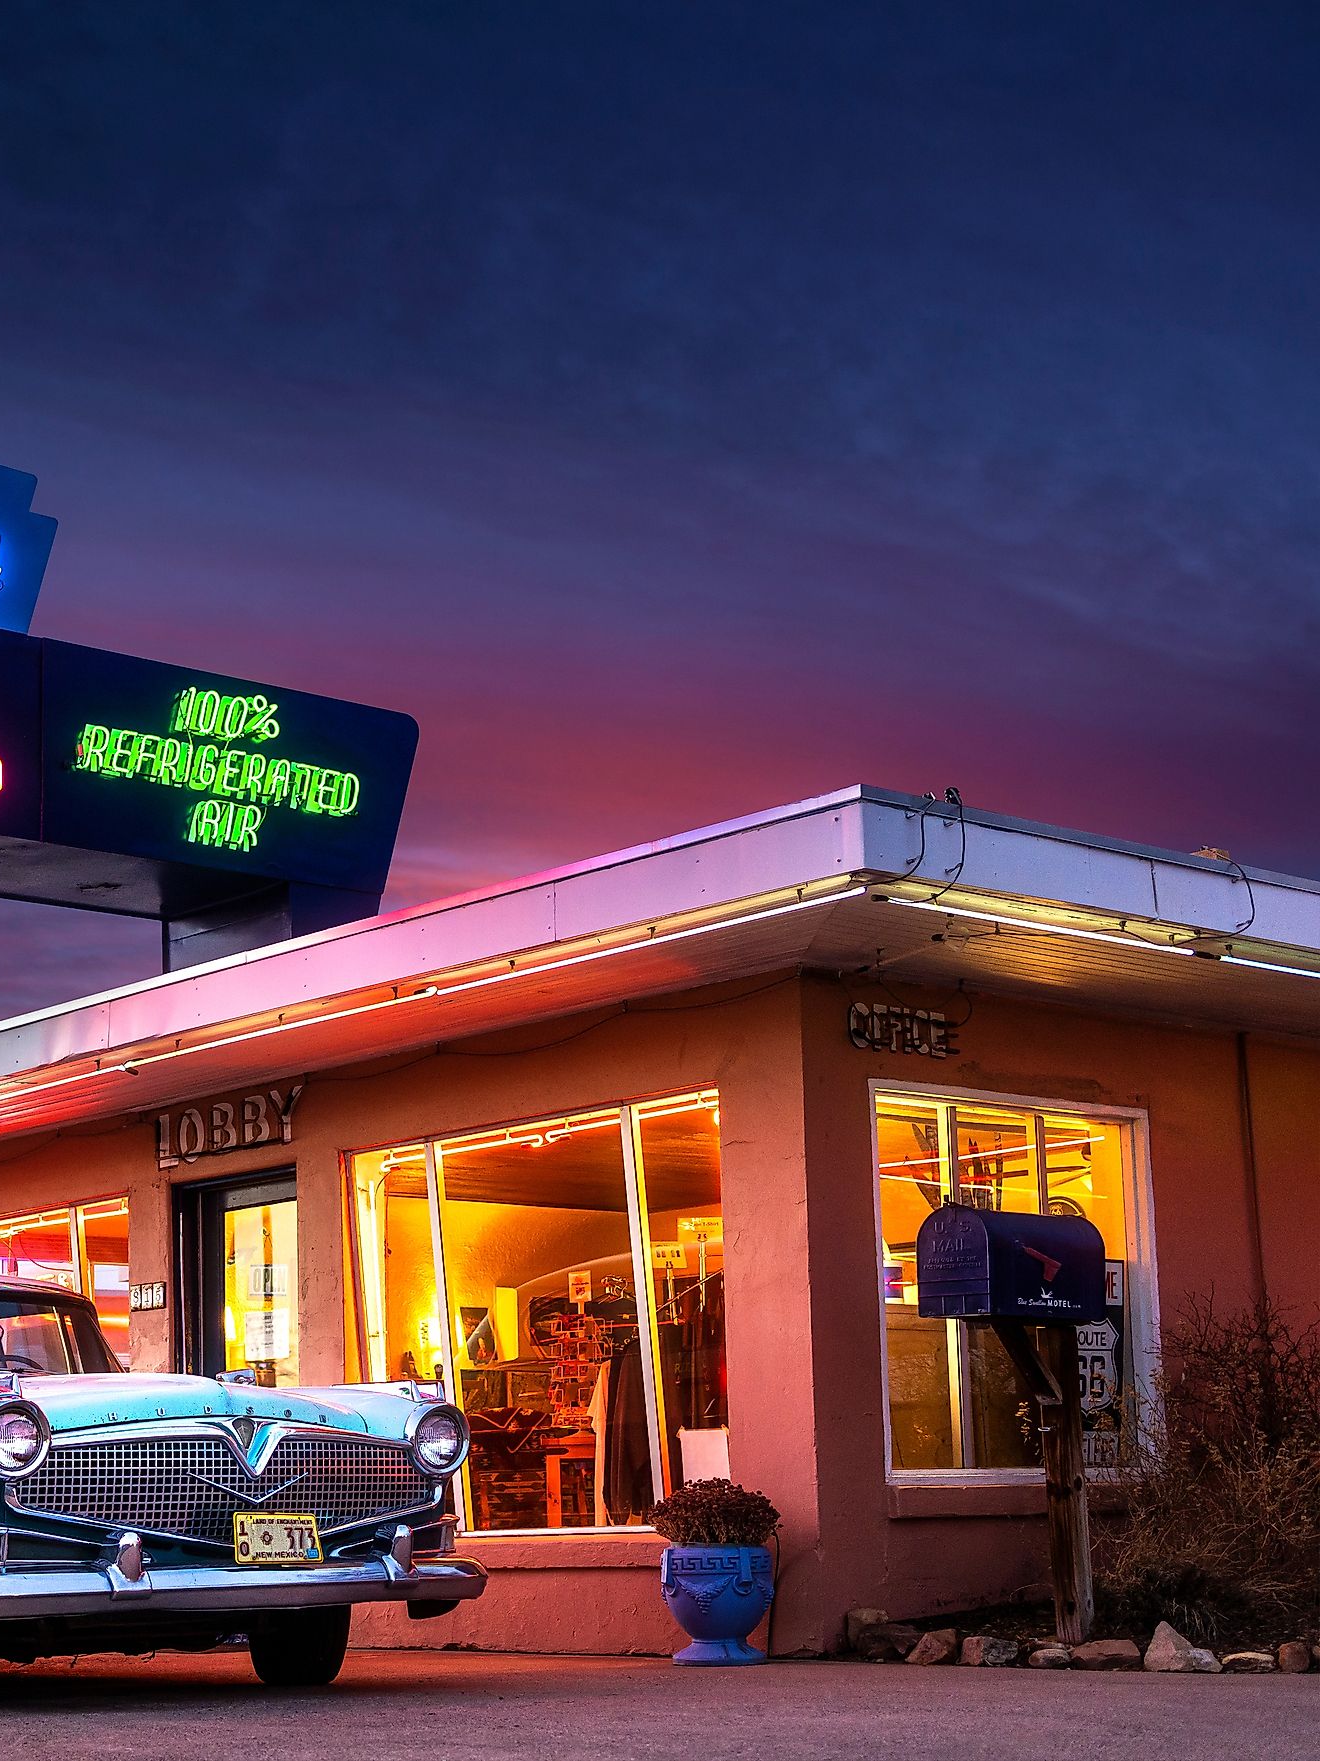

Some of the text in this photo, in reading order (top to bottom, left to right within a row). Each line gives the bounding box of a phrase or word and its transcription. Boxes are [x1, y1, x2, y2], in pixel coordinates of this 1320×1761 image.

[175, 687, 280, 741] 100%
[77, 724, 360, 816] REFRIGERATED
[188, 800, 263, 852] AIR
[848, 1002, 956, 1059] OFFICE
[157, 1086, 302, 1169] LOBBY
[932, 1238, 970, 1253] MAIL
[133, 1288, 162, 1304] 815
[1047, 1299, 1072, 1308] MOTEL
[1077, 1330, 1107, 1347] OUTE
[108, 1405, 328, 1422] HUDSON
[283, 1527, 315, 1549] 373
[255, 1551, 273, 1559] NEW
[274, 1551, 304, 1559] MEXICO
